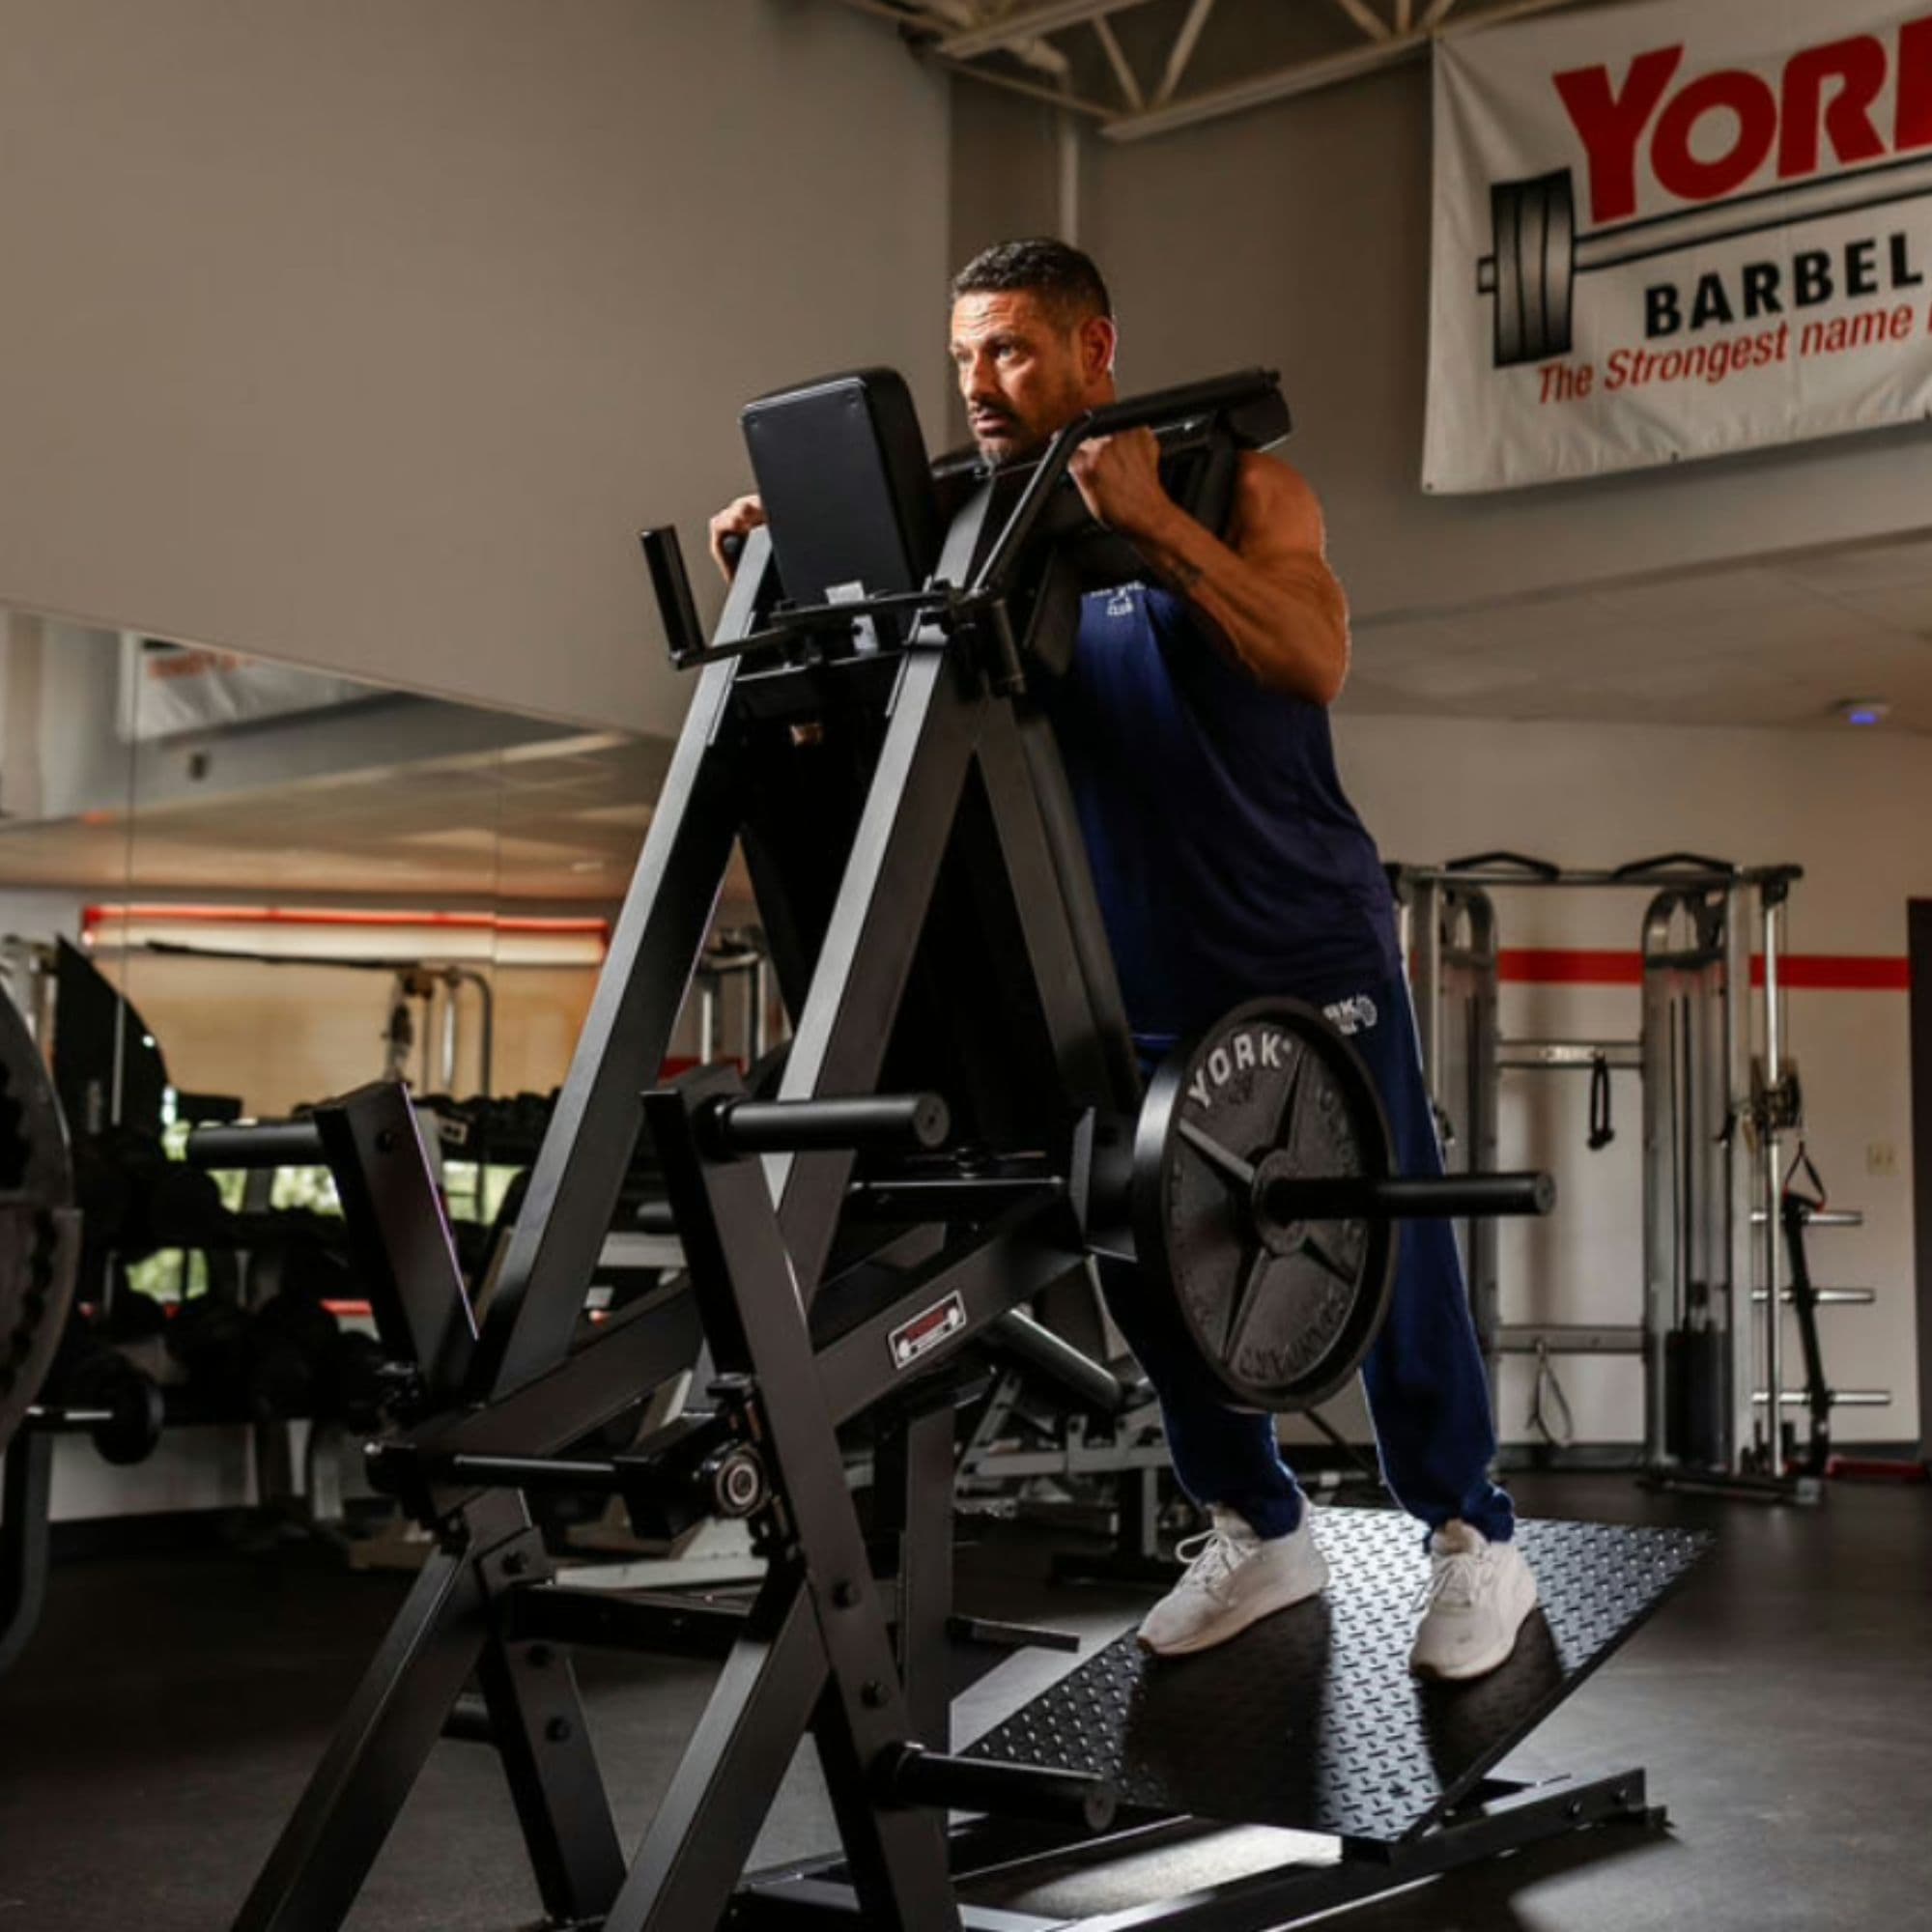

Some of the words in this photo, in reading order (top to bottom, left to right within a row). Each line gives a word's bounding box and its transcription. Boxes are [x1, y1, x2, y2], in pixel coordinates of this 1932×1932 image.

[1538, 362, 1594, 404] The
[1605, 322, 1790, 391] Strongest
[1800, 304, 1913, 356] name
[1188, 1032, 1283, 1109] YORK
